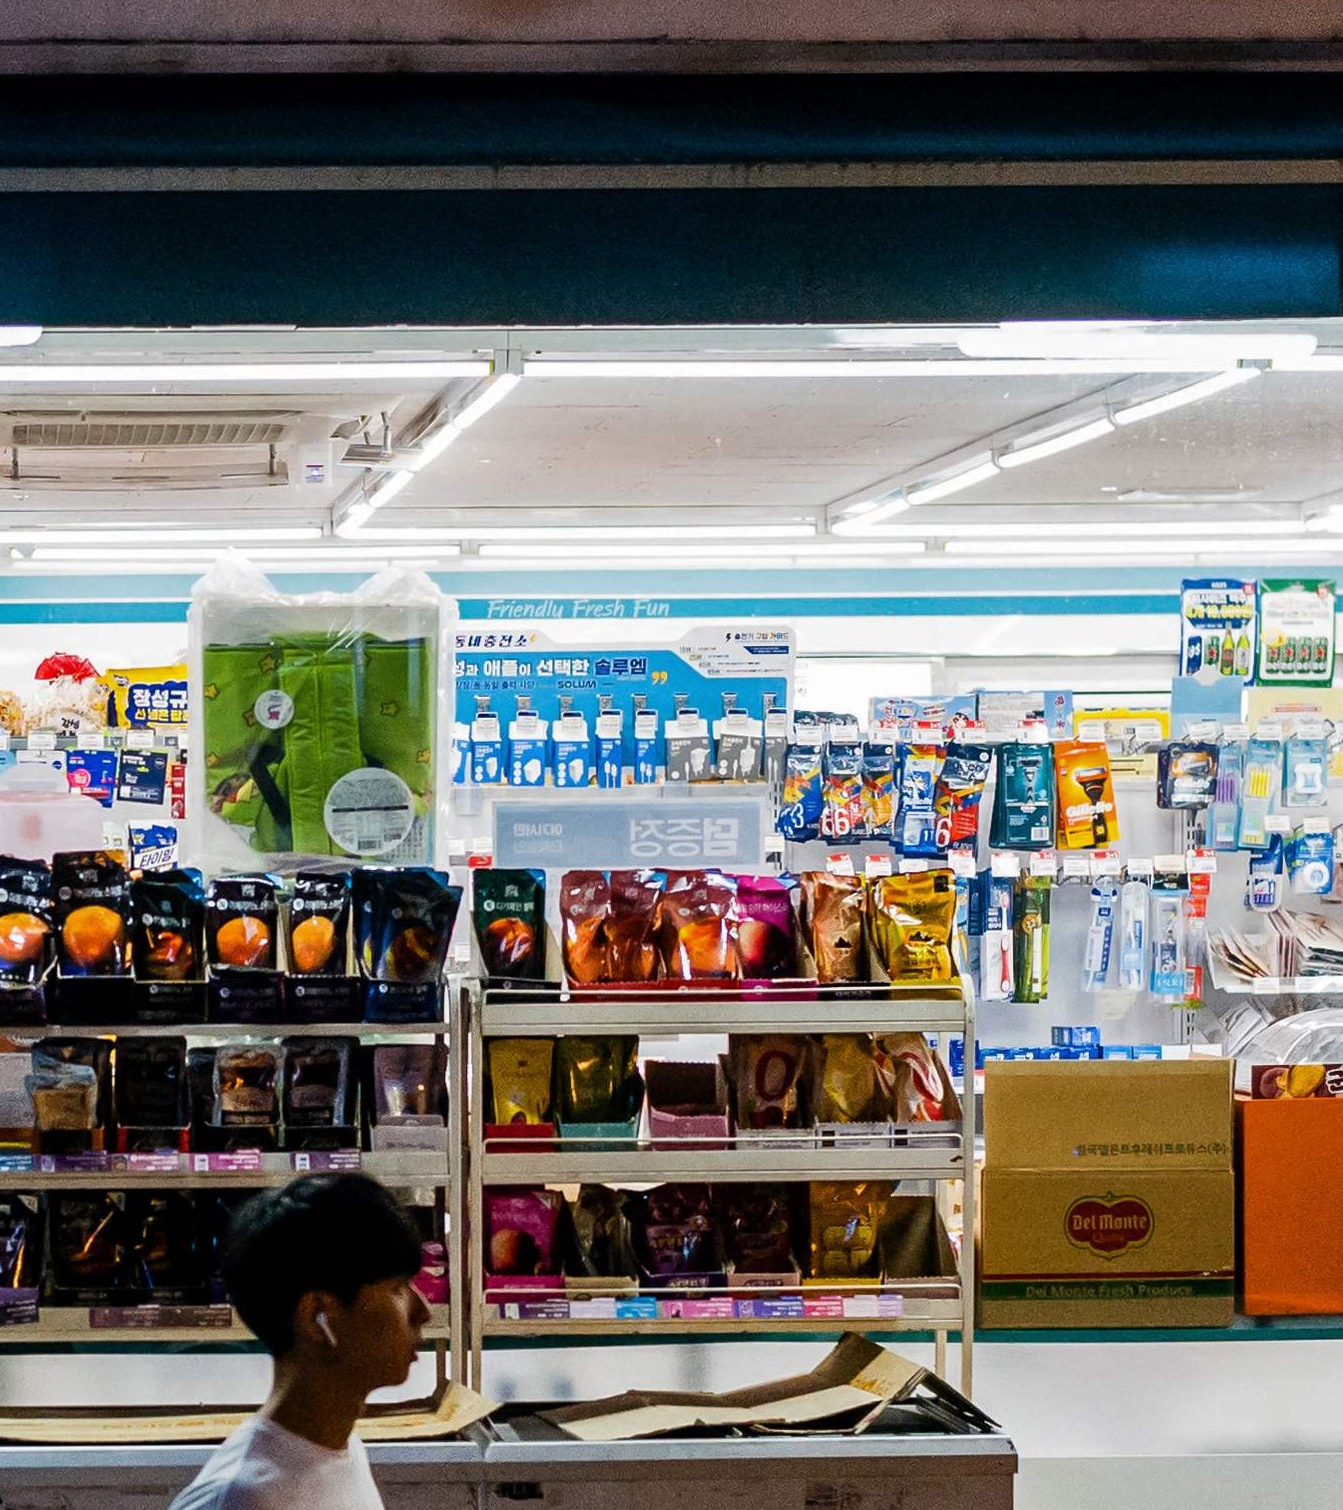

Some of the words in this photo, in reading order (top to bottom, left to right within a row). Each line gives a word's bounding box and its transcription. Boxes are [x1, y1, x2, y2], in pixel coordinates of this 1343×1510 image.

[487, 600, 563, 619] Friendly
[572, 600, 624, 617] Fresh
[633, 600, 669, 617] Fun
[536, 658, 589, 676] 선택한
[595, 658, 647, 676] 솔루엠
[557, 681, 597, 689] SOLUM
[1066, 804, 1113, 818] Gillette
[1073, 1215, 1096, 1230] Del
[1099, 1214, 1148, 1230] Monte
[1026, 1286, 1046, 1298] Del
[1051, 1285, 1096, 1297] Monte
[1099, 1285, 1133, 1297] Fresh
[1139, 1284, 1193, 1296] Produce
